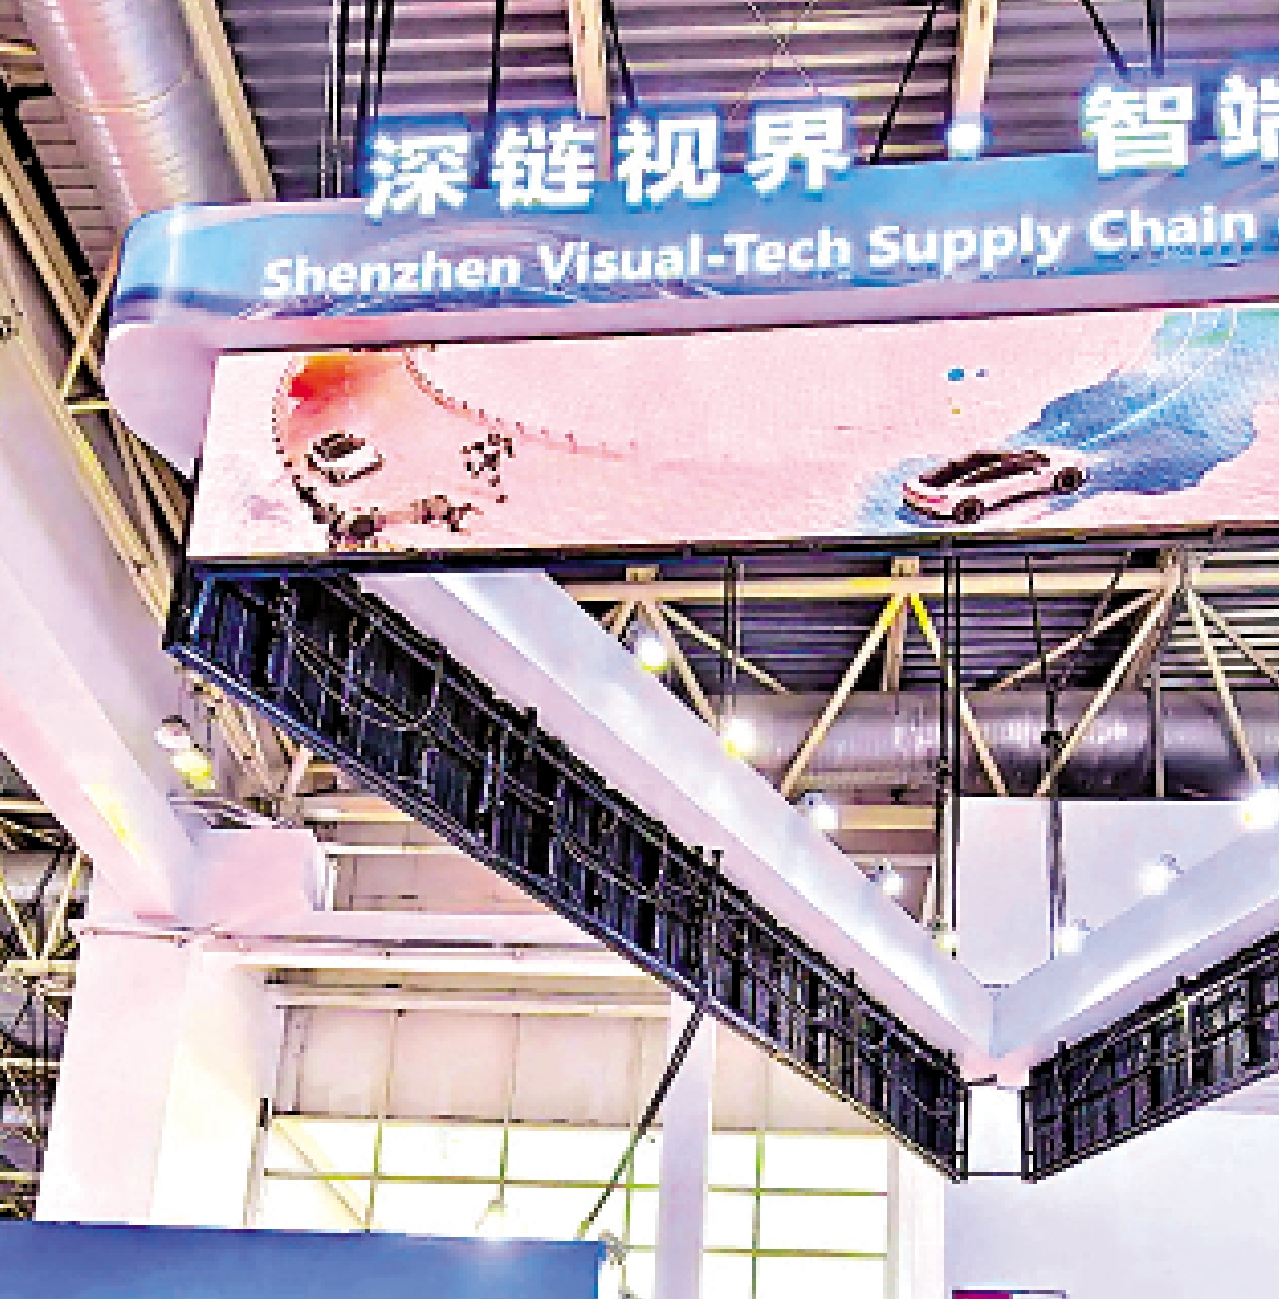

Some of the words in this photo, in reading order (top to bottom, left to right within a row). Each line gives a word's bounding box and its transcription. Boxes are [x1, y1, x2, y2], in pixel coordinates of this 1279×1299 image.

[364, 107, 850, 218] 深链视界
[262, 250, 519, 299] Shenzhen
[536, 229, 852, 284] Visual-Tech
[868, 214, 1071, 279] Supply
[1089, 204, 1259, 253] Chain
